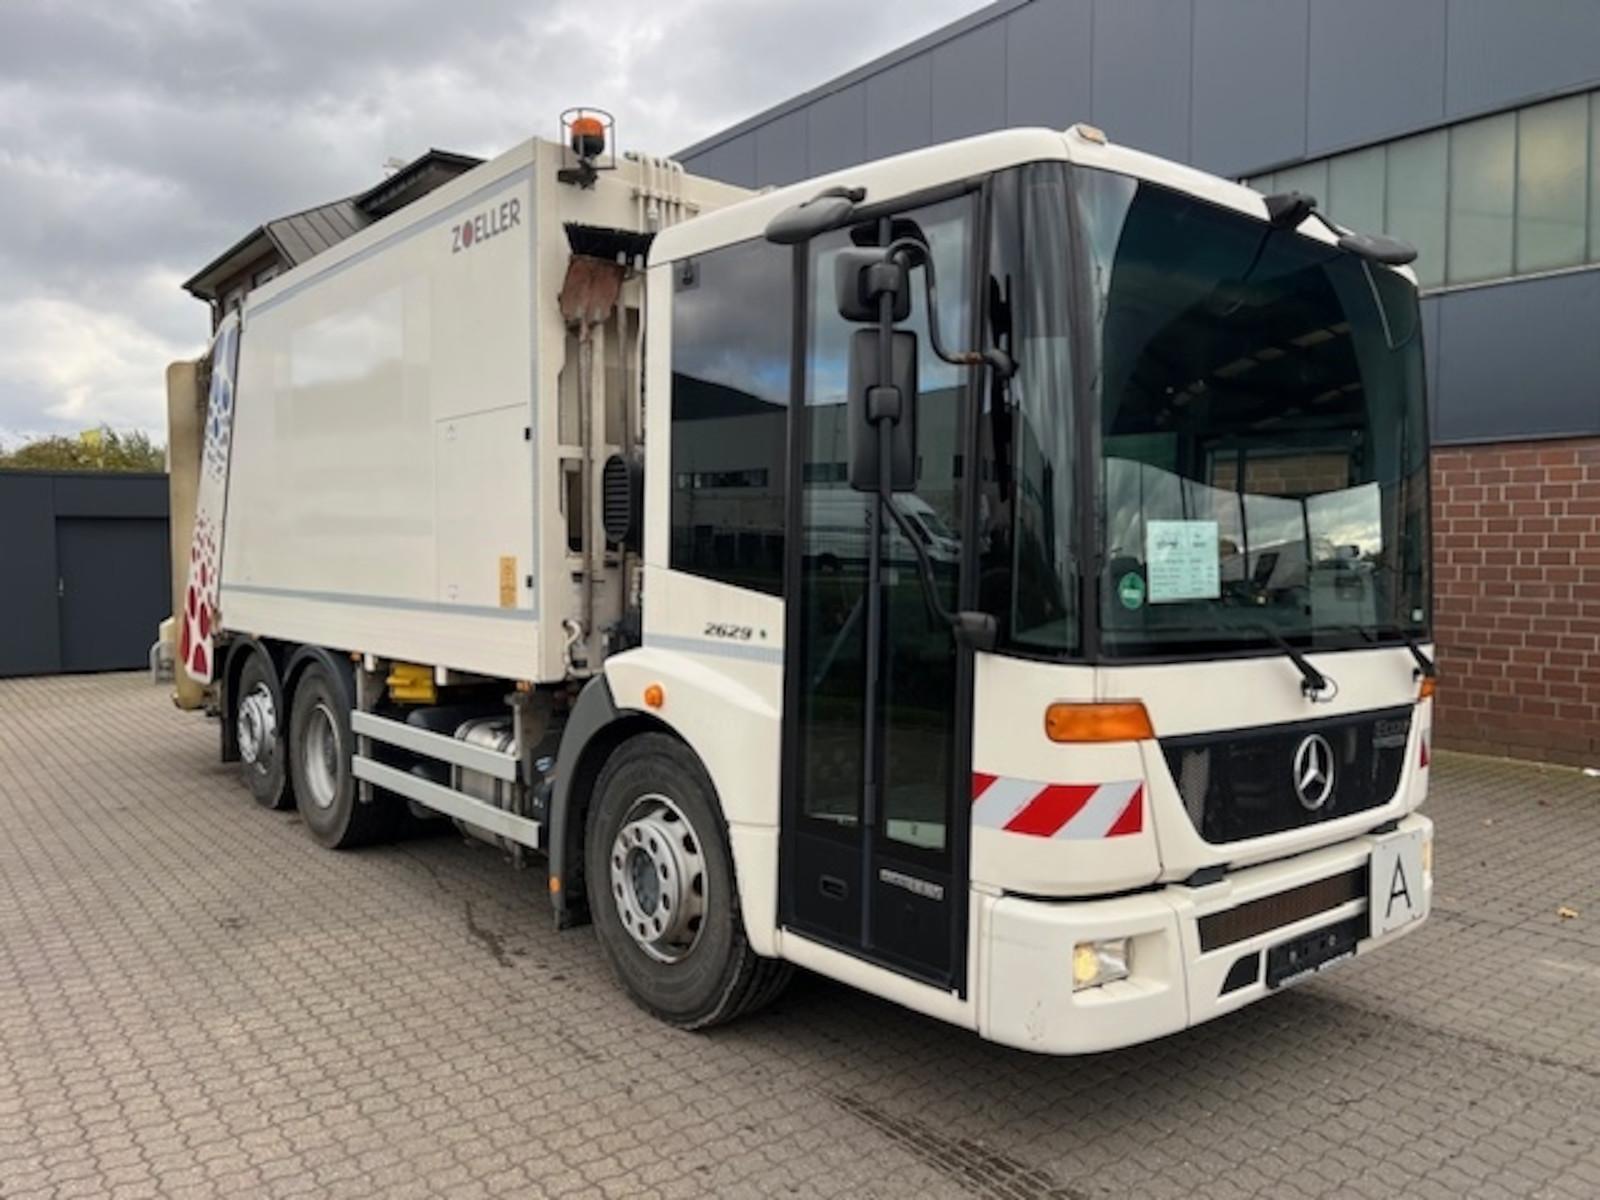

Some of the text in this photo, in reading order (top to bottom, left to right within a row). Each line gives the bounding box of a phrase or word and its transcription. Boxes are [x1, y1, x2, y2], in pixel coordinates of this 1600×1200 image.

[452, 198, 520, 253] ZOELLER
[704, 621, 752, 640] 2629
[1385, 852, 1411, 917] A
